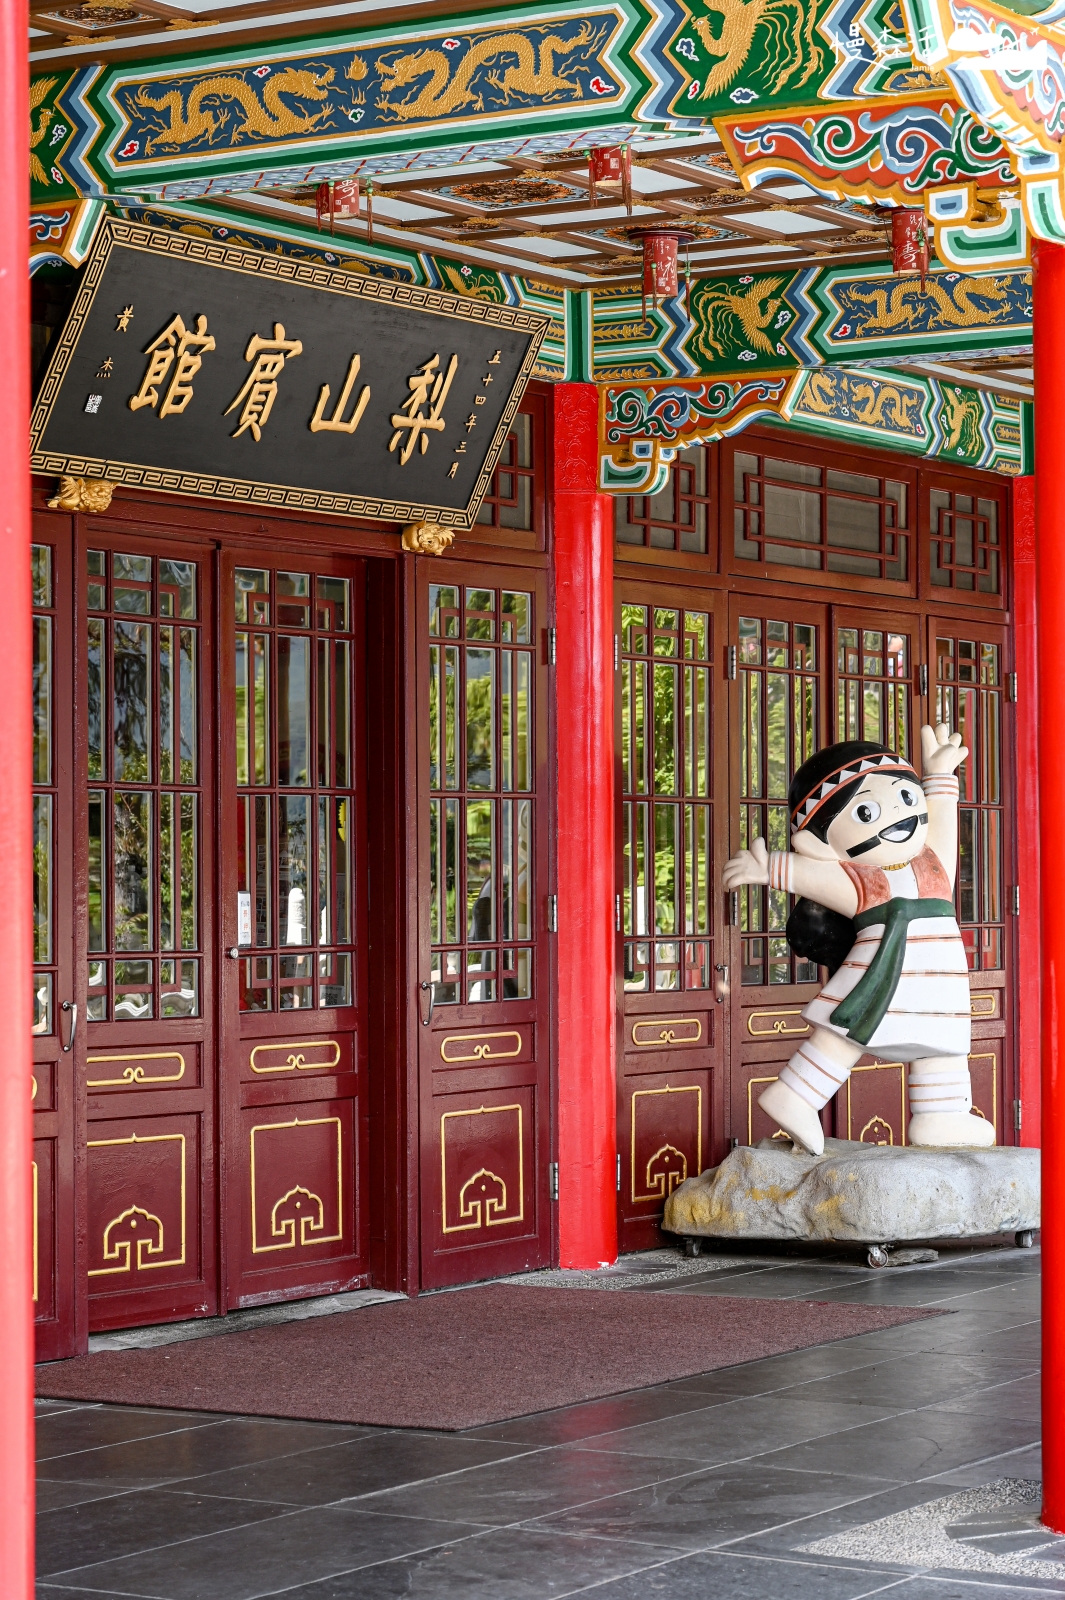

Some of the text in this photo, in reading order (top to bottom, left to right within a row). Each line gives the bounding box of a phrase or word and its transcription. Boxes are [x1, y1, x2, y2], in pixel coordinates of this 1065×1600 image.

[129, 313, 459, 466] 梨山賓館
[447, 350, 501, 479] 五十四年三月
